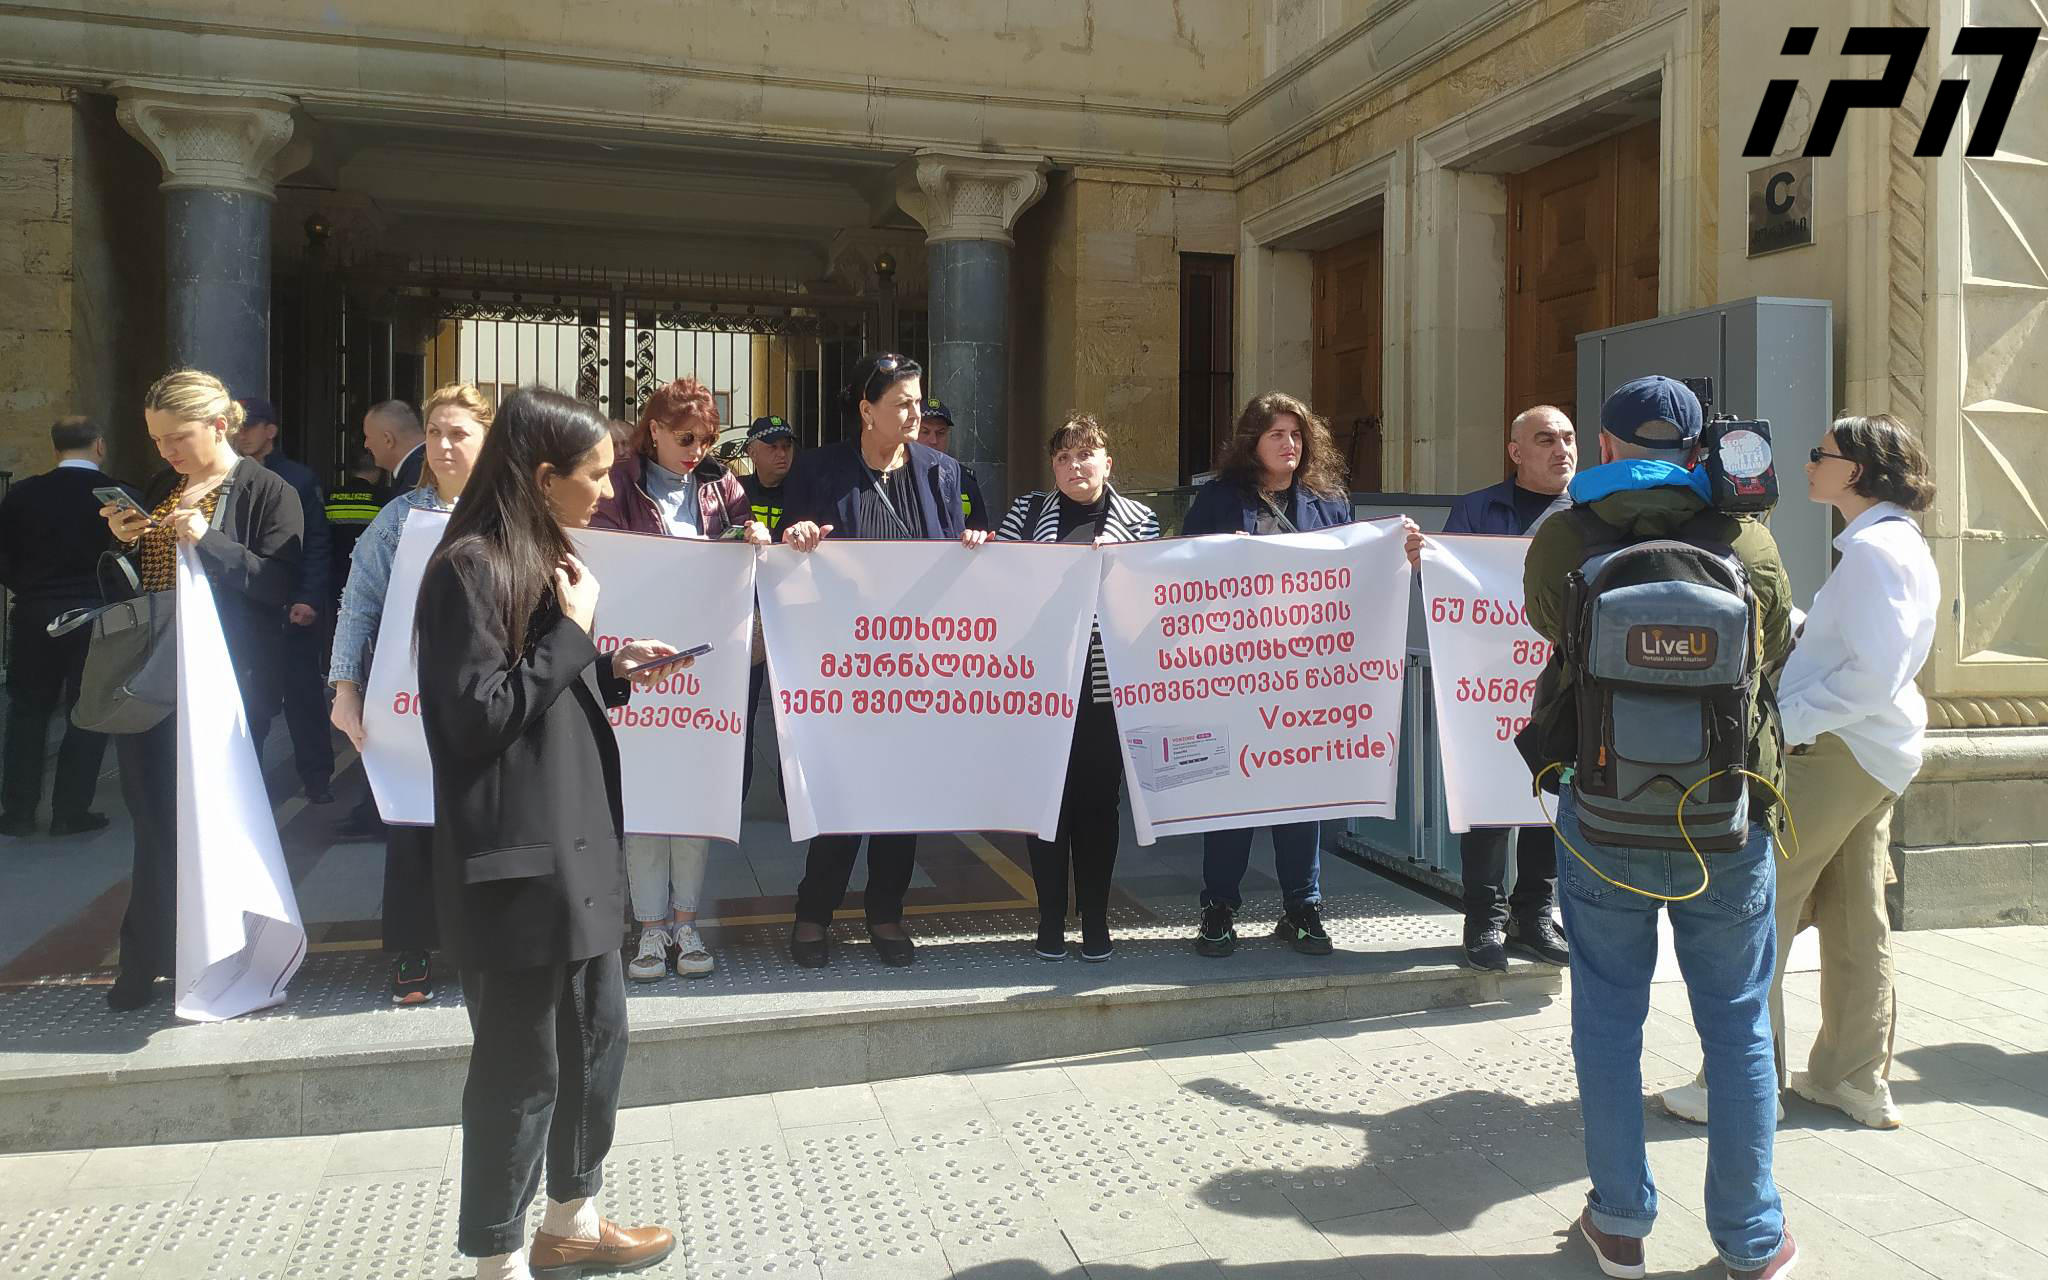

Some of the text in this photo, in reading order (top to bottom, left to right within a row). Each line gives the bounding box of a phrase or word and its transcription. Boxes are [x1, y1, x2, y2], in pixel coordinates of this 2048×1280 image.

[1765, 172, 1795, 214] C
[1154, 568, 1350, 605] ვითხოვთ ჩვენი
[1161, 601, 1351, 637] შვილებისთვის
[1432, 598, 1464, 623] ნუ
[855, 616, 996, 642] ვითხოვთ
[1641, 629, 1706, 655] LiveU
[1159, 631, 1354, 670] სასიცოცხლოდ
[821, 653, 1034, 679] მკურნალობას
[852, 690, 1073, 718] შვილებისთვის
[1260, 704, 1372, 728] Voxzogo
[1240, 733, 1395, 776] (vosoritide)
